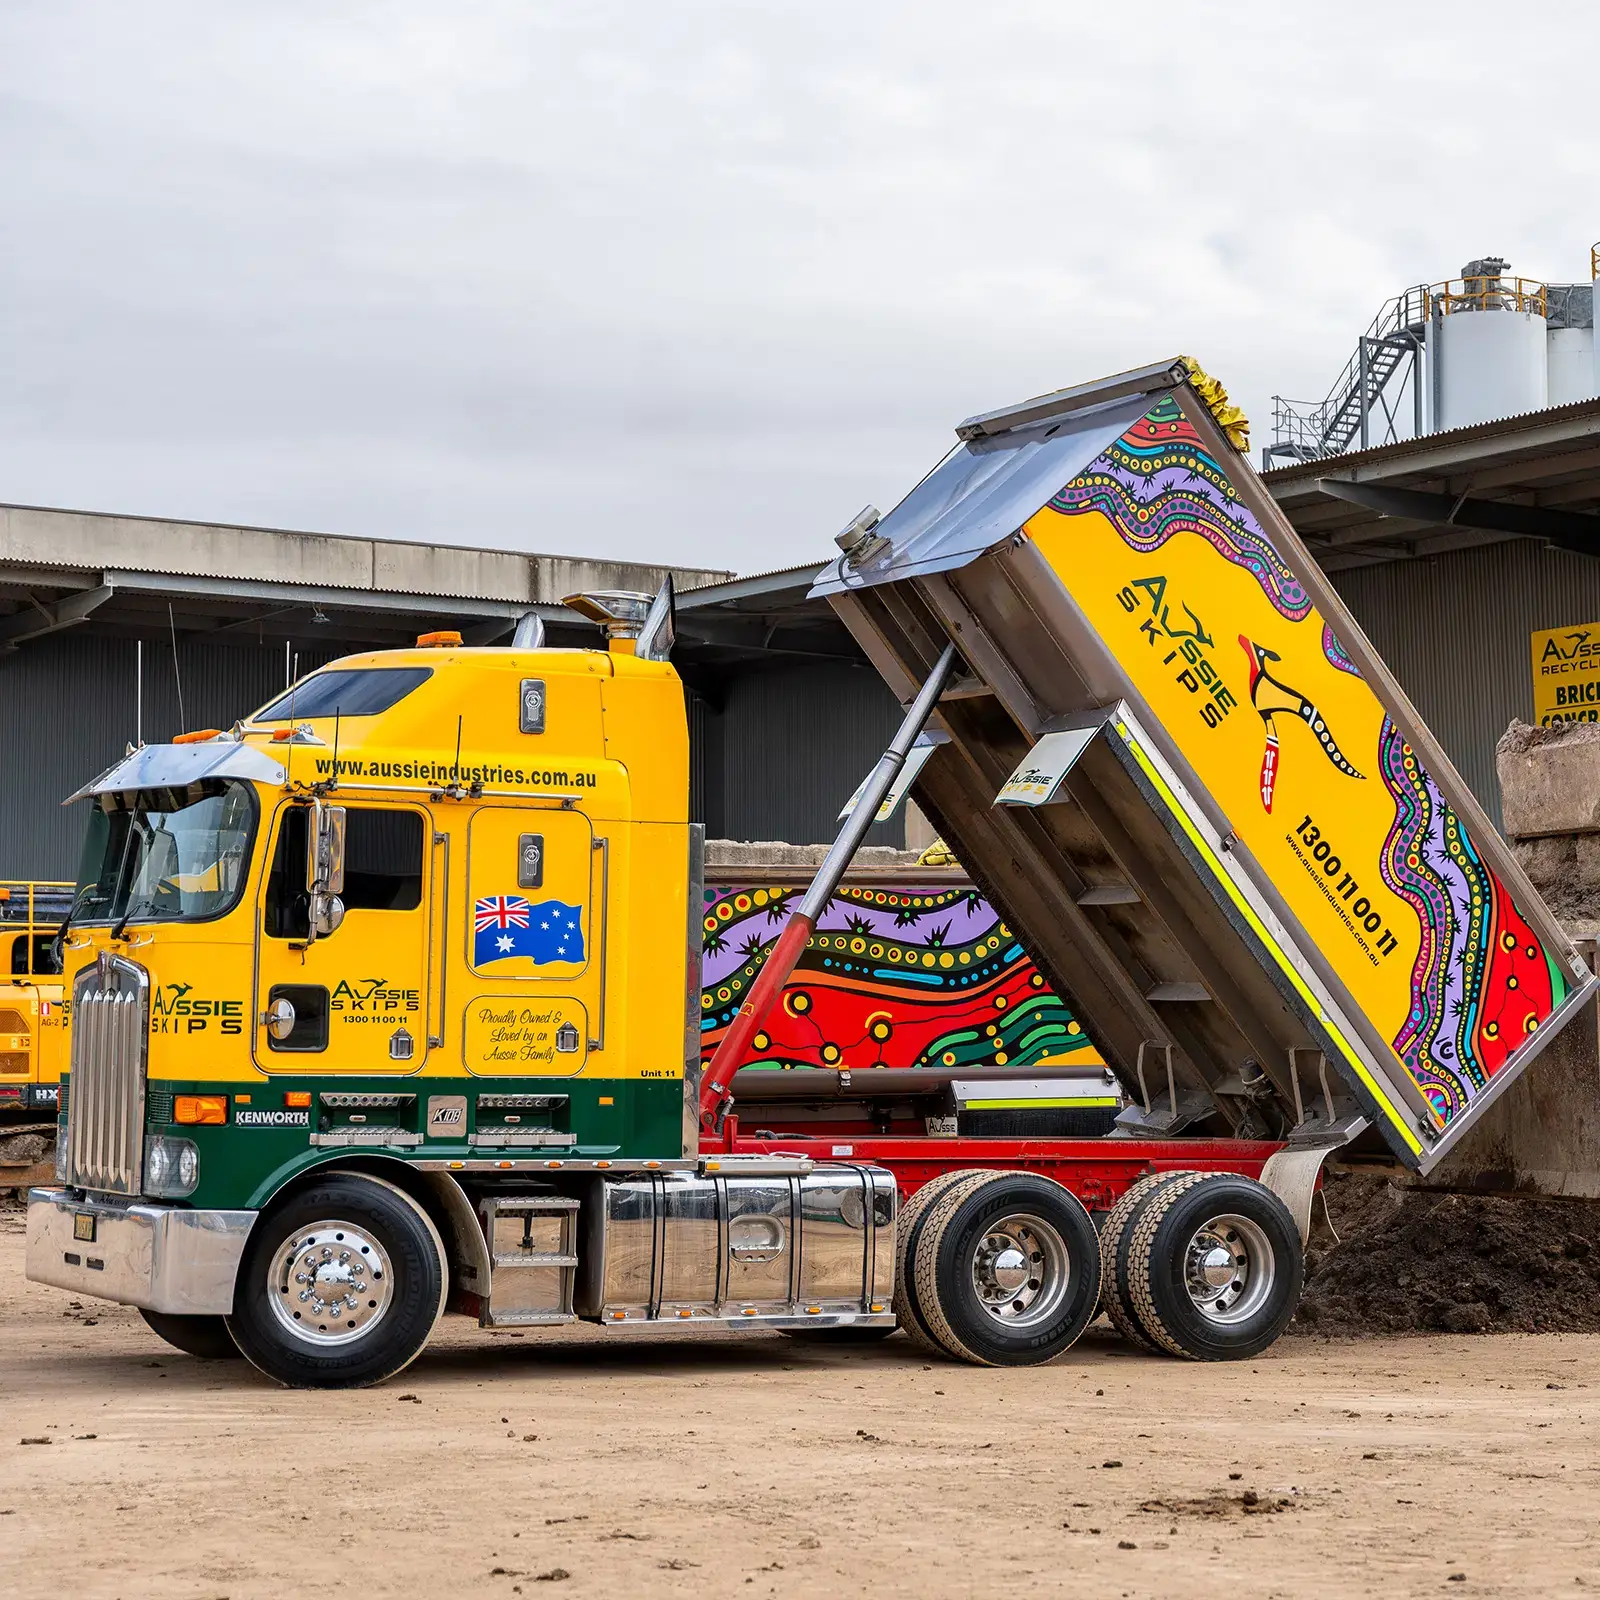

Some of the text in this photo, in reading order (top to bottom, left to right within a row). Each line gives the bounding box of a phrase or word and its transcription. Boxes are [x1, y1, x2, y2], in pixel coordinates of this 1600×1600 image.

[1131, 576, 1238, 716] AUSSIE
[1116, 586, 1223, 728] SKIPS
[315, 759, 596, 787] www.aussieindustries.com.au
[1296, 815, 1399, 957] 1300 11 00 11
[1285, 833, 1380, 967] www.aussieindustries.com.au
[331, 978, 419, 1000] AUSSIE
[152, 983, 243, 1016] AUSSIE
[331, 1000, 419, 1011] SKIPS
[41, 1018, 59, 1027] AG-2
[152, 1017, 242, 1035] SKIPS
[343, 1015, 368, 1024] 1300
[398, 1015, 407, 1024] 11
[479, 1008, 517, 1028] Proudly
[520, 1008, 553, 1024] Owned
[490, 1026, 548, 1045] Loved by an
[483, 1045, 555, 1065] Aussie Family
[641, 1069, 675, 1078] Unit 11
[235, 1111, 309, 1124] KENWORTH
